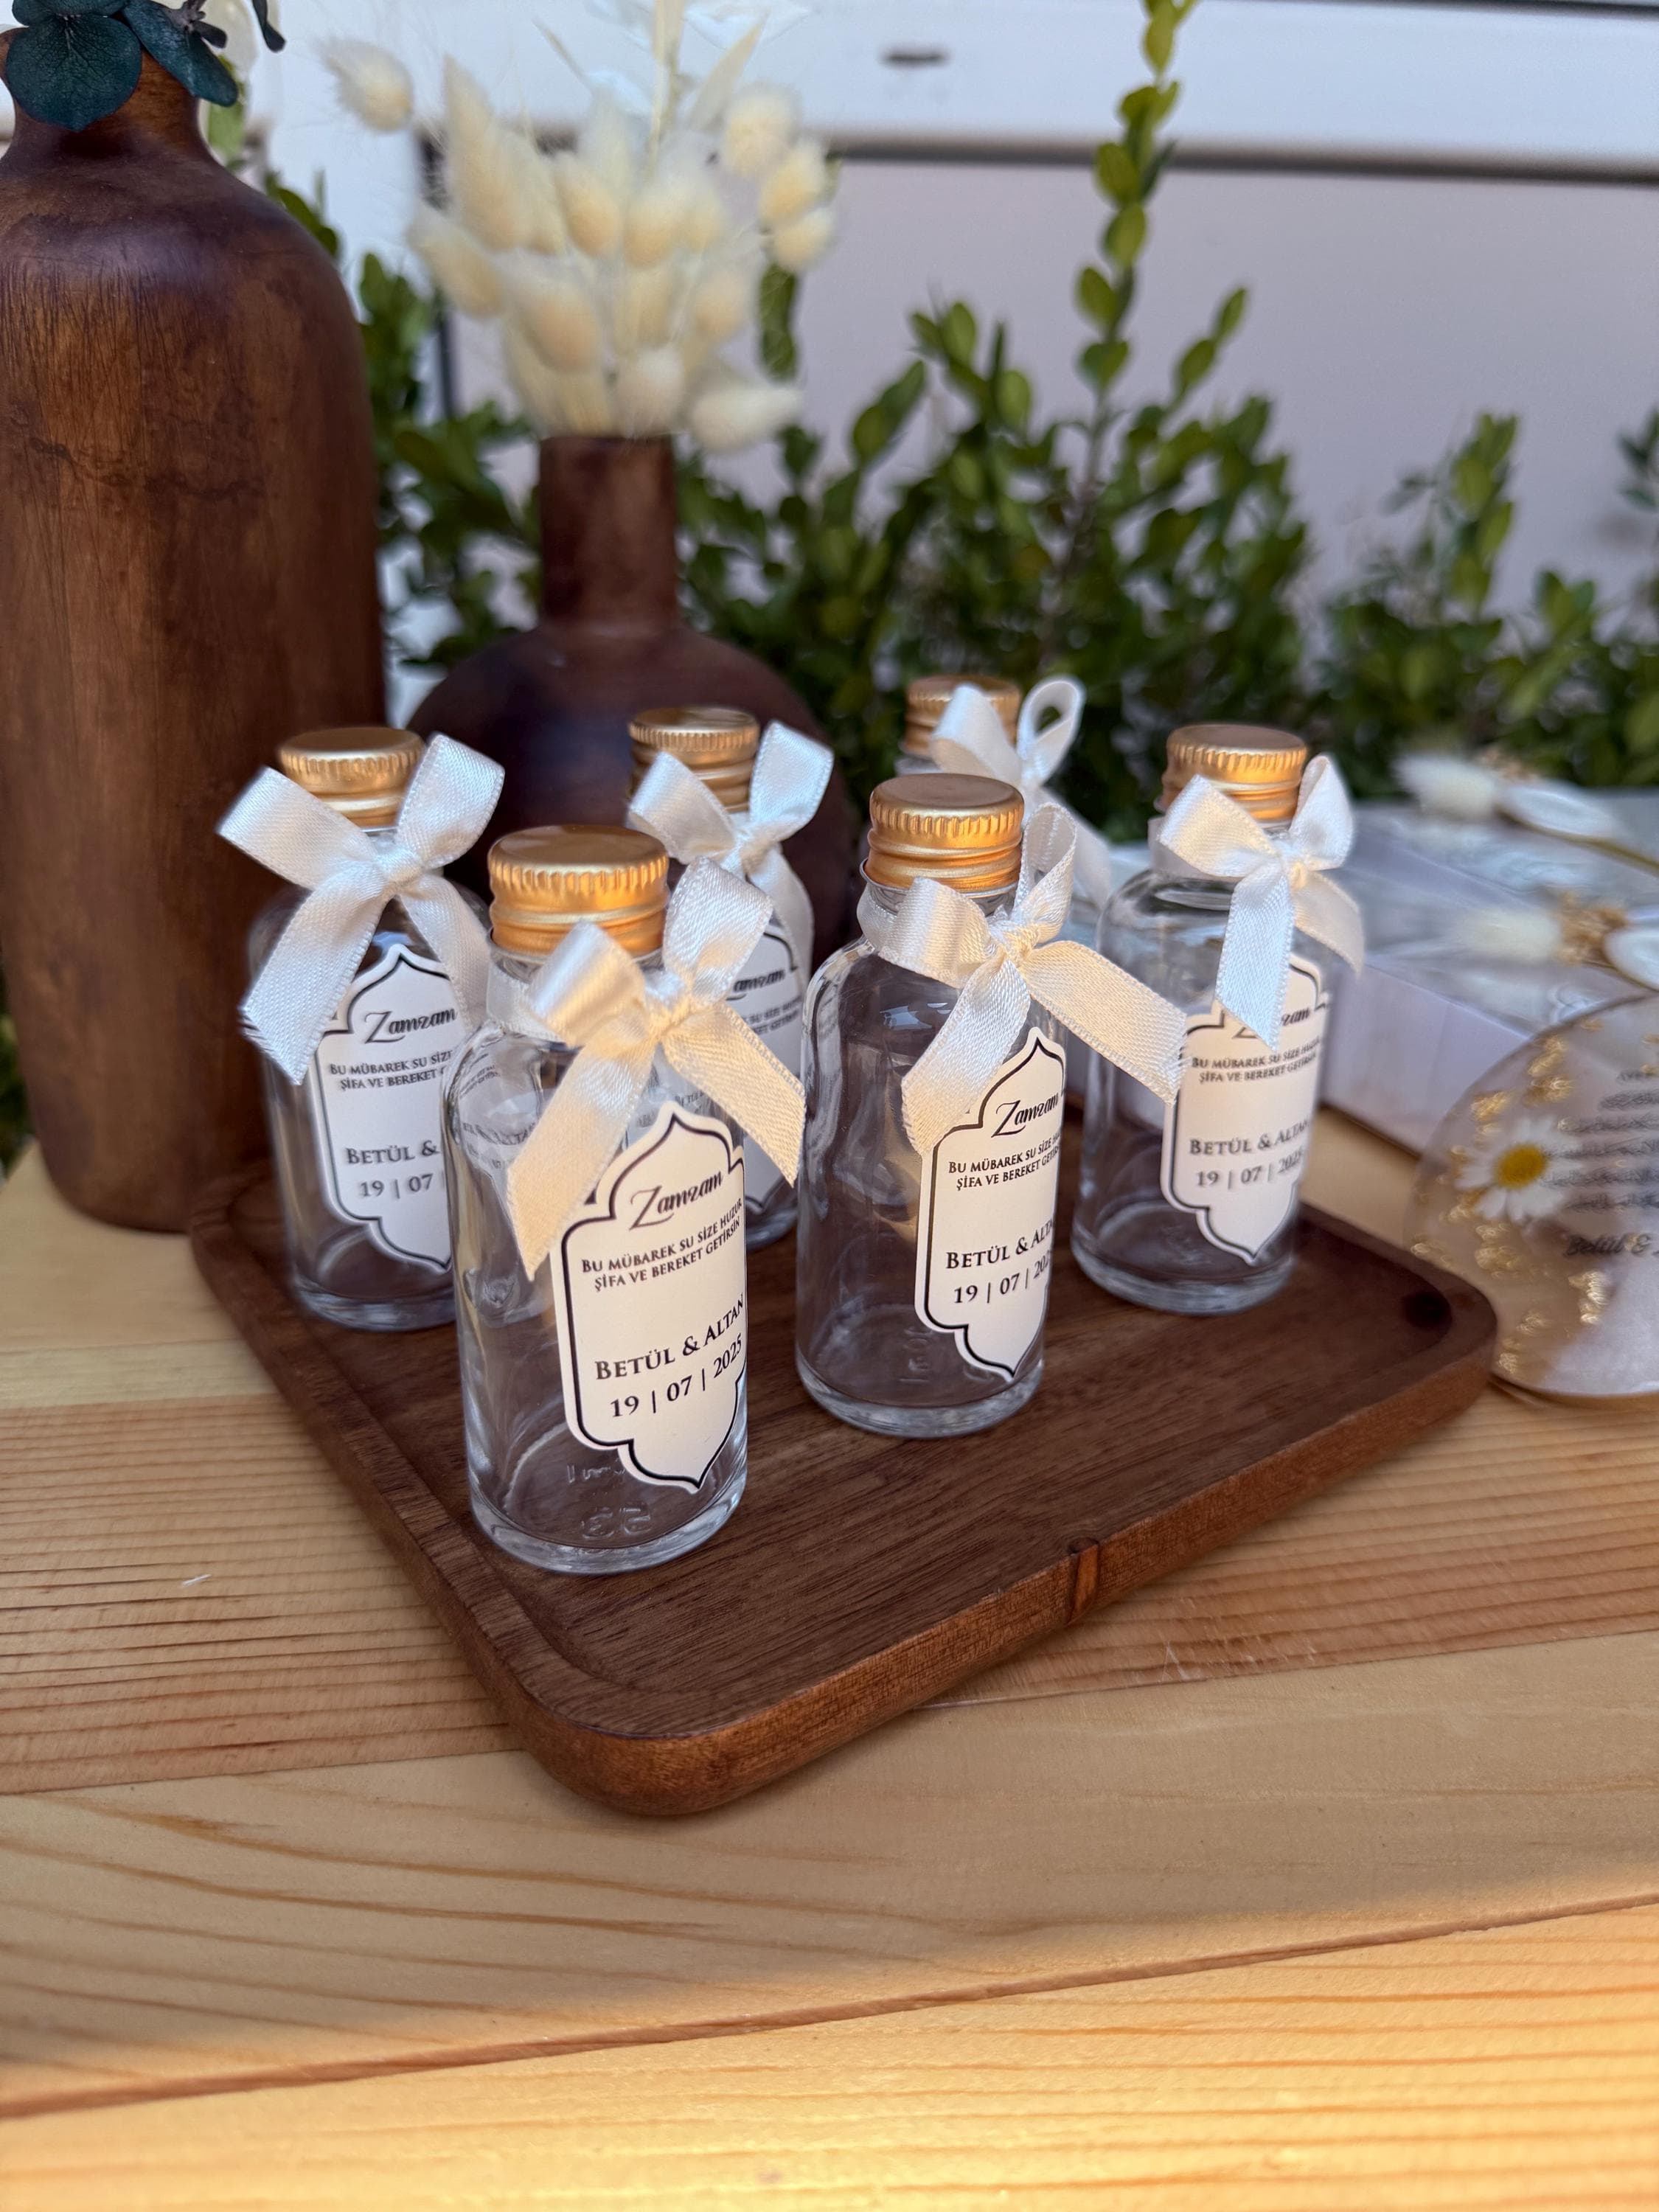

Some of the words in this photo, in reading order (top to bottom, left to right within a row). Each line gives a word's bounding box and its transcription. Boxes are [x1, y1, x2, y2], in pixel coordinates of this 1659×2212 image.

[364, 1008, 457, 1044] Zamzam
[350, 1060, 410, 1075] MÜBAREK
[412, 1057, 427, 1067] SU
[1199, 1071, 1223, 1083] ŞİFA
[1227, 1072, 1240, 1082] VE
[1244, 1067, 1285, 1080] BEREKET
[1211, 1057, 1265, 1068] MÜBAREK
[341, 1077, 366, 1091] ŞİFA
[368, 1077, 384, 1088] VE
[386, 1068, 437, 1087] BEREKET
[991, 1093, 1058, 1138] Zamzam
[346, 1144, 416, 1164] BETÜL
[421, 1139, 440, 1157] &
[970, 1152, 1023, 1172] MÜBAREK
[1026, 1147, 1036, 1160] SU
[1038, 1138, 1051, 1155] SİZE
[1189, 1138, 1252, 1155] BETÜL
[1257, 1134, 1271, 1150] &
[360, 1180, 384, 1197] 19
[408, 1173, 434, 1192] 07
[956, 1175, 982, 1191] ŞİFA
[985, 1174, 999, 1185] VE
[1003, 1159, 1040, 1182] BEREKET
[1197, 1170, 1219, 1186] 19
[1241, 1165, 1262, 1184] 07
[629, 1171, 723, 1231] Zamzam
[582, 1259, 602, 1273] BU
[608, 1243, 677, 1270] MÜBAREK
[679, 1236, 694, 1251] SU
[698, 1222, 717, 1243] SİZE
[720, 1197, 742, 1230] HUZUR
[595, 1274, 626, 1292] ŞİFA
[629, 1270, 647, 1283] VE
[652, 1248, 703, 1277] BEREKET
[706, 1216, 740, 1255] GETİRSİN
[945, 1245, 1010, 1269] BETÜL
[1015, 1237, 1029, 1255] &
[954, 1285, 978, 1304] 19
[1000, 1273, 1020, 1295] 07
[594, 1347, 675, 1380] BETÜL
[682, 1336, 700, 1356] &
[703, 1294, 743, 1346] ALTAN
[611, 1396, 639, 1417] 19
[667, 1374, 692, 1402] 07
[714, 1333, 742, 1378] 2025
